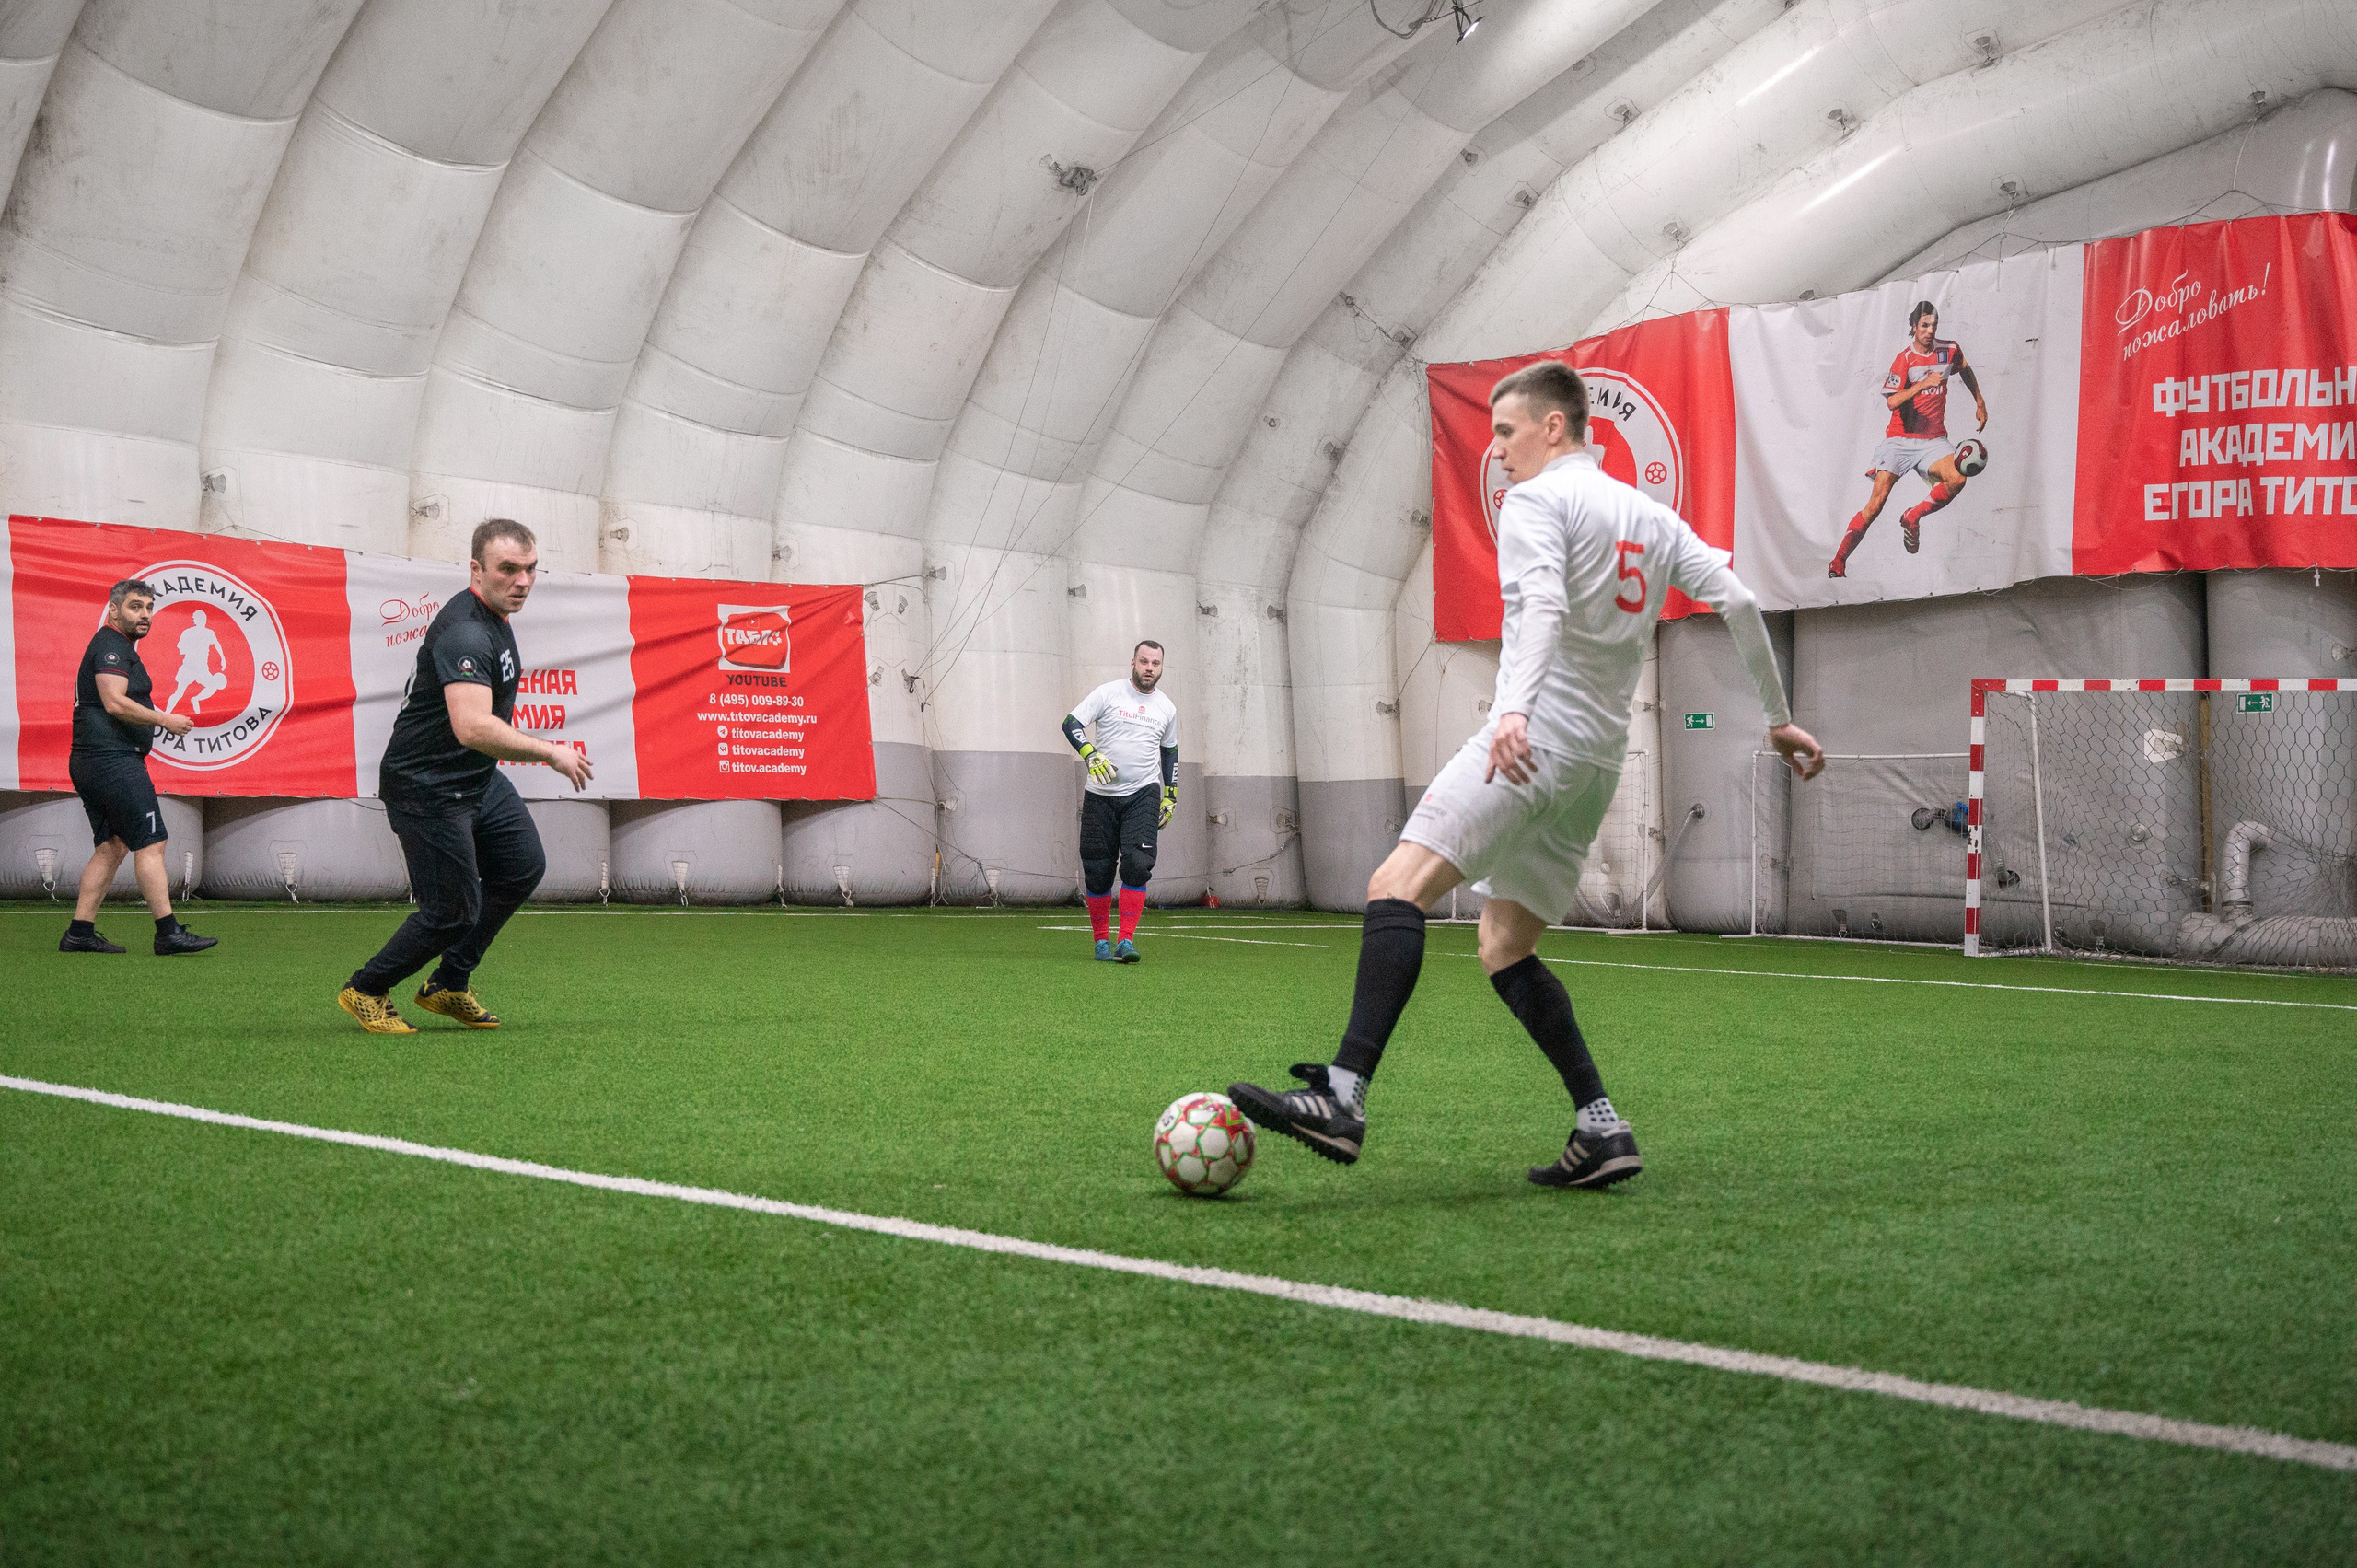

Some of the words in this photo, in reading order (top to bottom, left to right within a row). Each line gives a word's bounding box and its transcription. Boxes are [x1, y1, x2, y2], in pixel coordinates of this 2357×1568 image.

[2115, 269, 2202, 336] Добро
[2122, 262, 2270, 361] пожаловать!
[2153, 366, 2357, 418] ФУТБОЛЬН
[2179, 421, 2357, 468] АКАДЕМИ
[2144, 477, 2254, 521] ЕГОРА
[1615, 540, 1647, 614] 5
[379, 591, 440, 627] Добро
[386, 625, 427, 647] пожа
[500, 649, 515, 683] 25
[726, 674, 787, 688] YOUTUBE
[709, 693, 716, 704] 8
[720, 694, 749, 708] (495)
[751, 694, 804, 707] 009-89-30
[194, 707, 272, 754] ТИТОВА
[697, 711, 818, 726] www.titovacademy.ru
[731, 728, 805, 742] titovacademy
[732, 745, 805, 759] titovacademy
[732, 761, 807, 775] titov.academy
